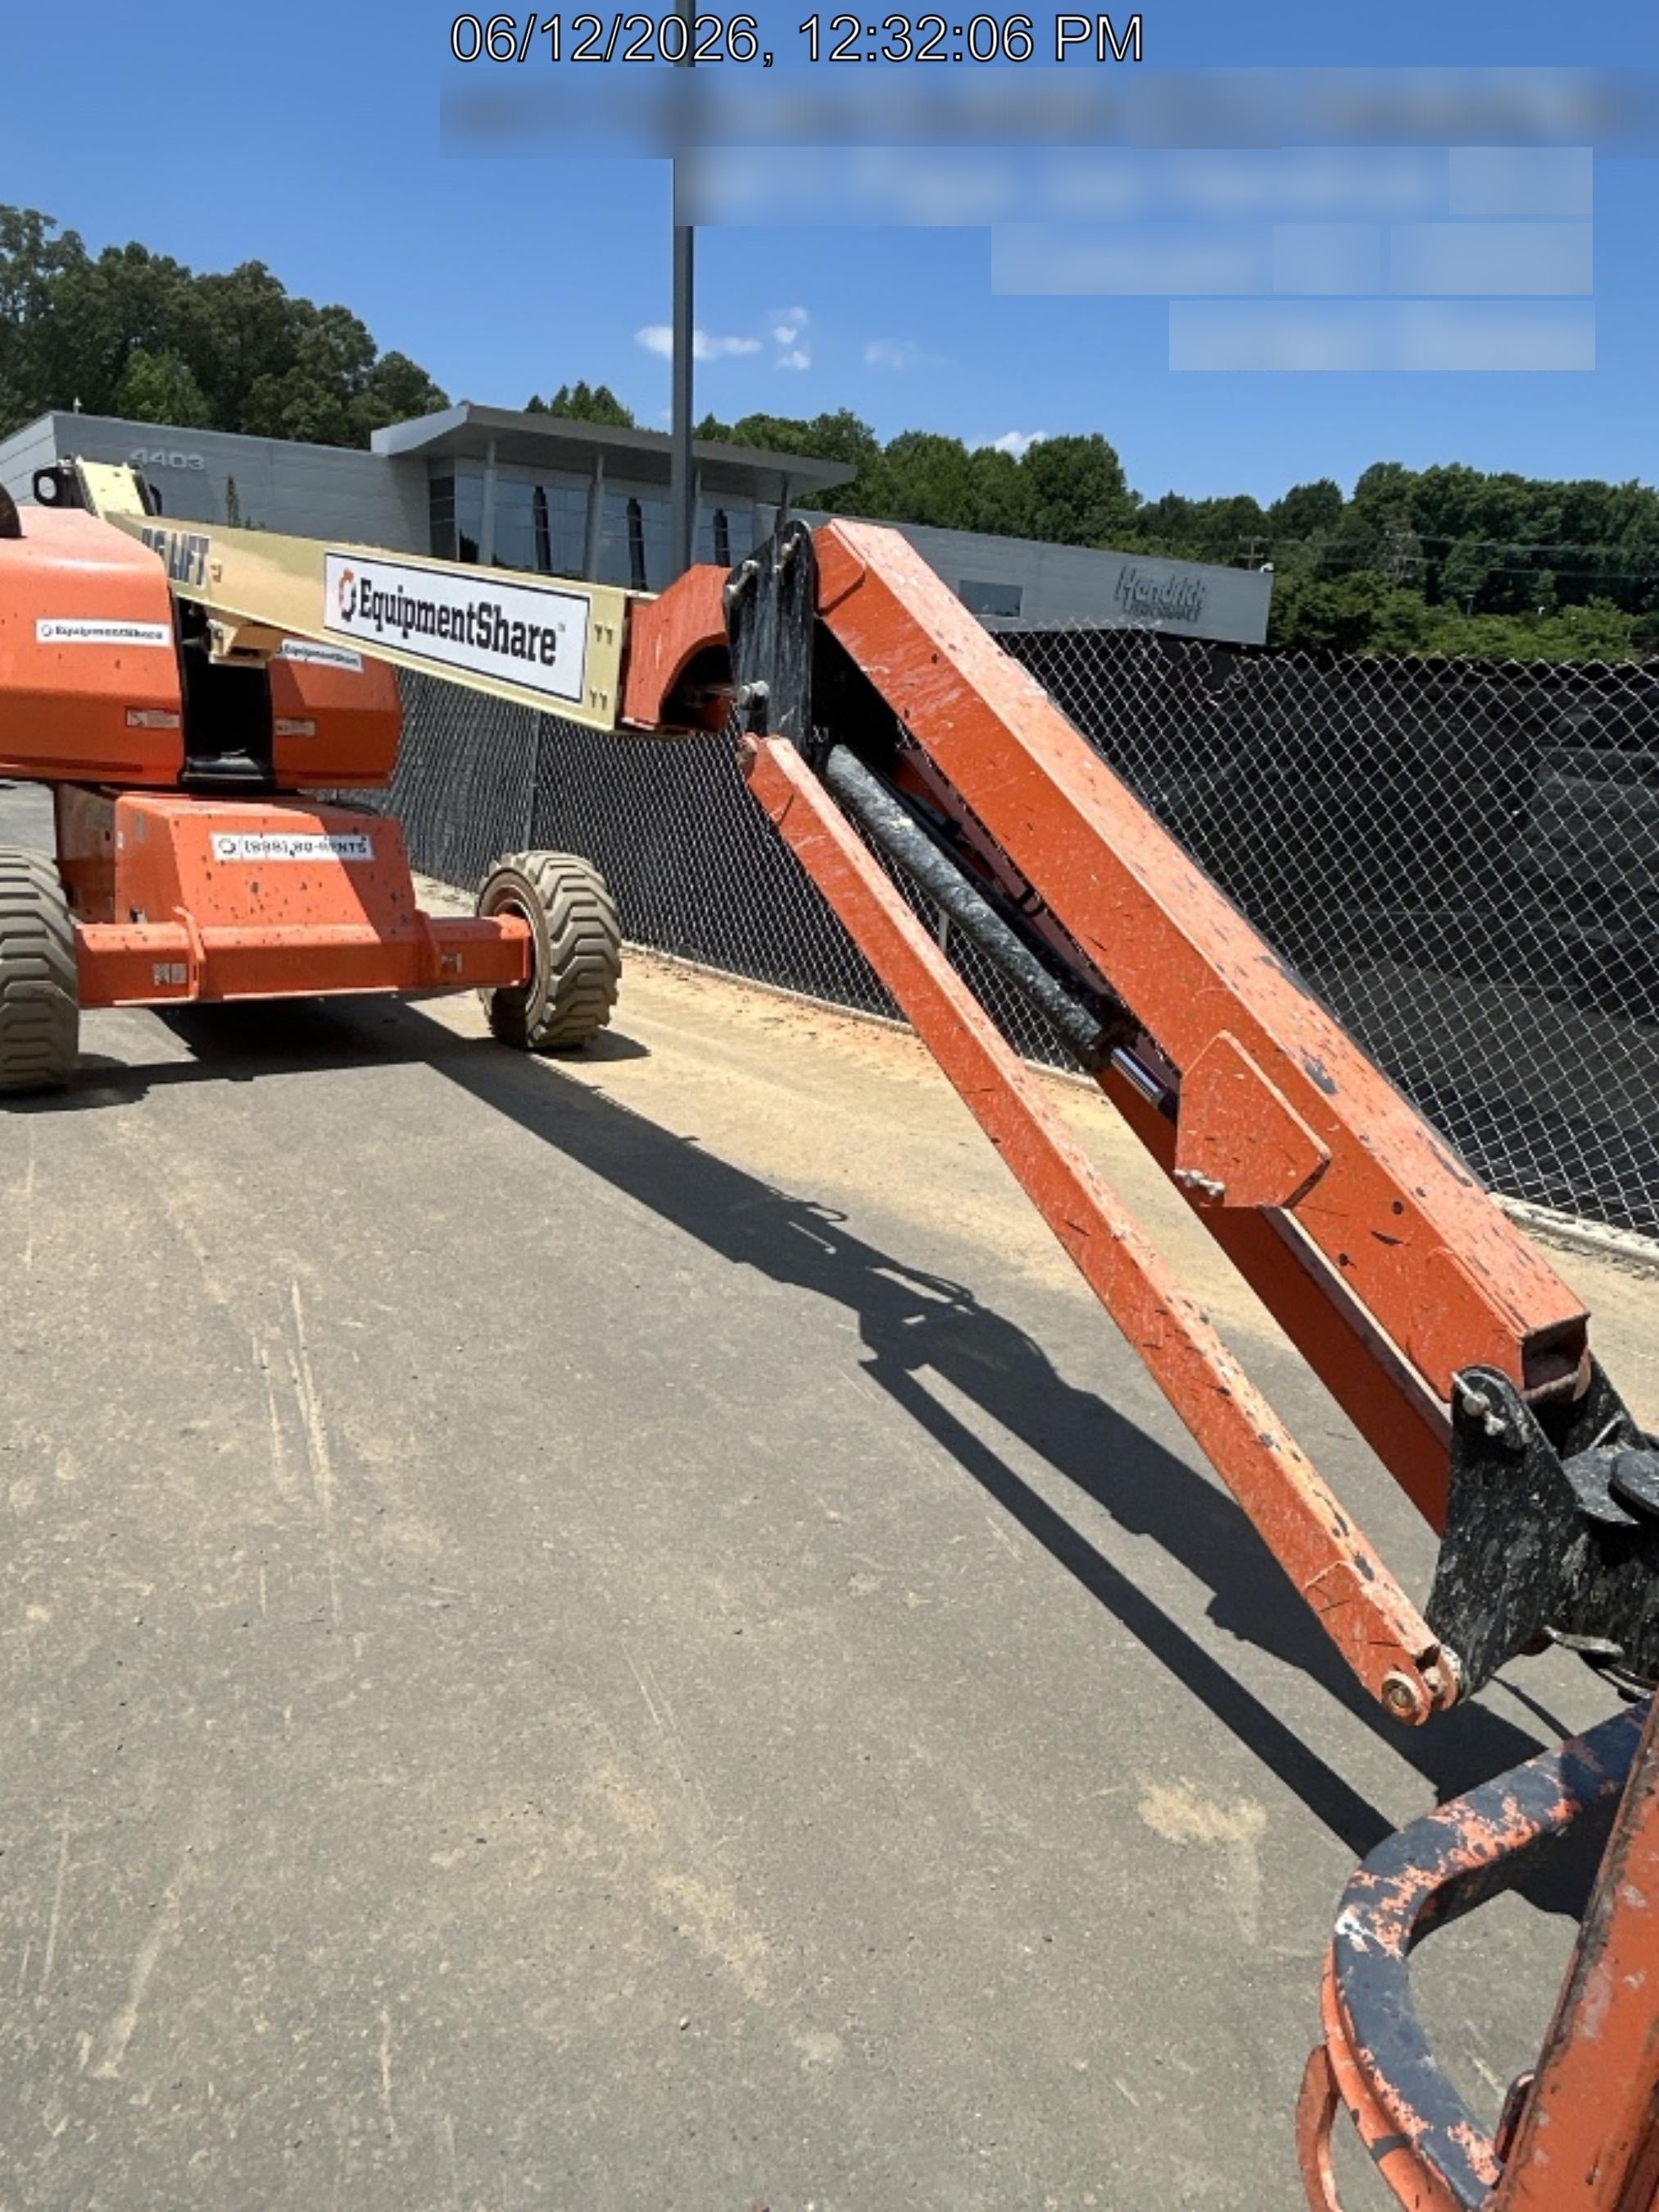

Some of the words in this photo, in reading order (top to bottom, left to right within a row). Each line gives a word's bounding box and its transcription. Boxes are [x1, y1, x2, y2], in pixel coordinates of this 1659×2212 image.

[129, 448, 204, 470] 4403
[168, 531, 211, 589] LIFT
[360, 578, 557, 667] EquipmentShare
